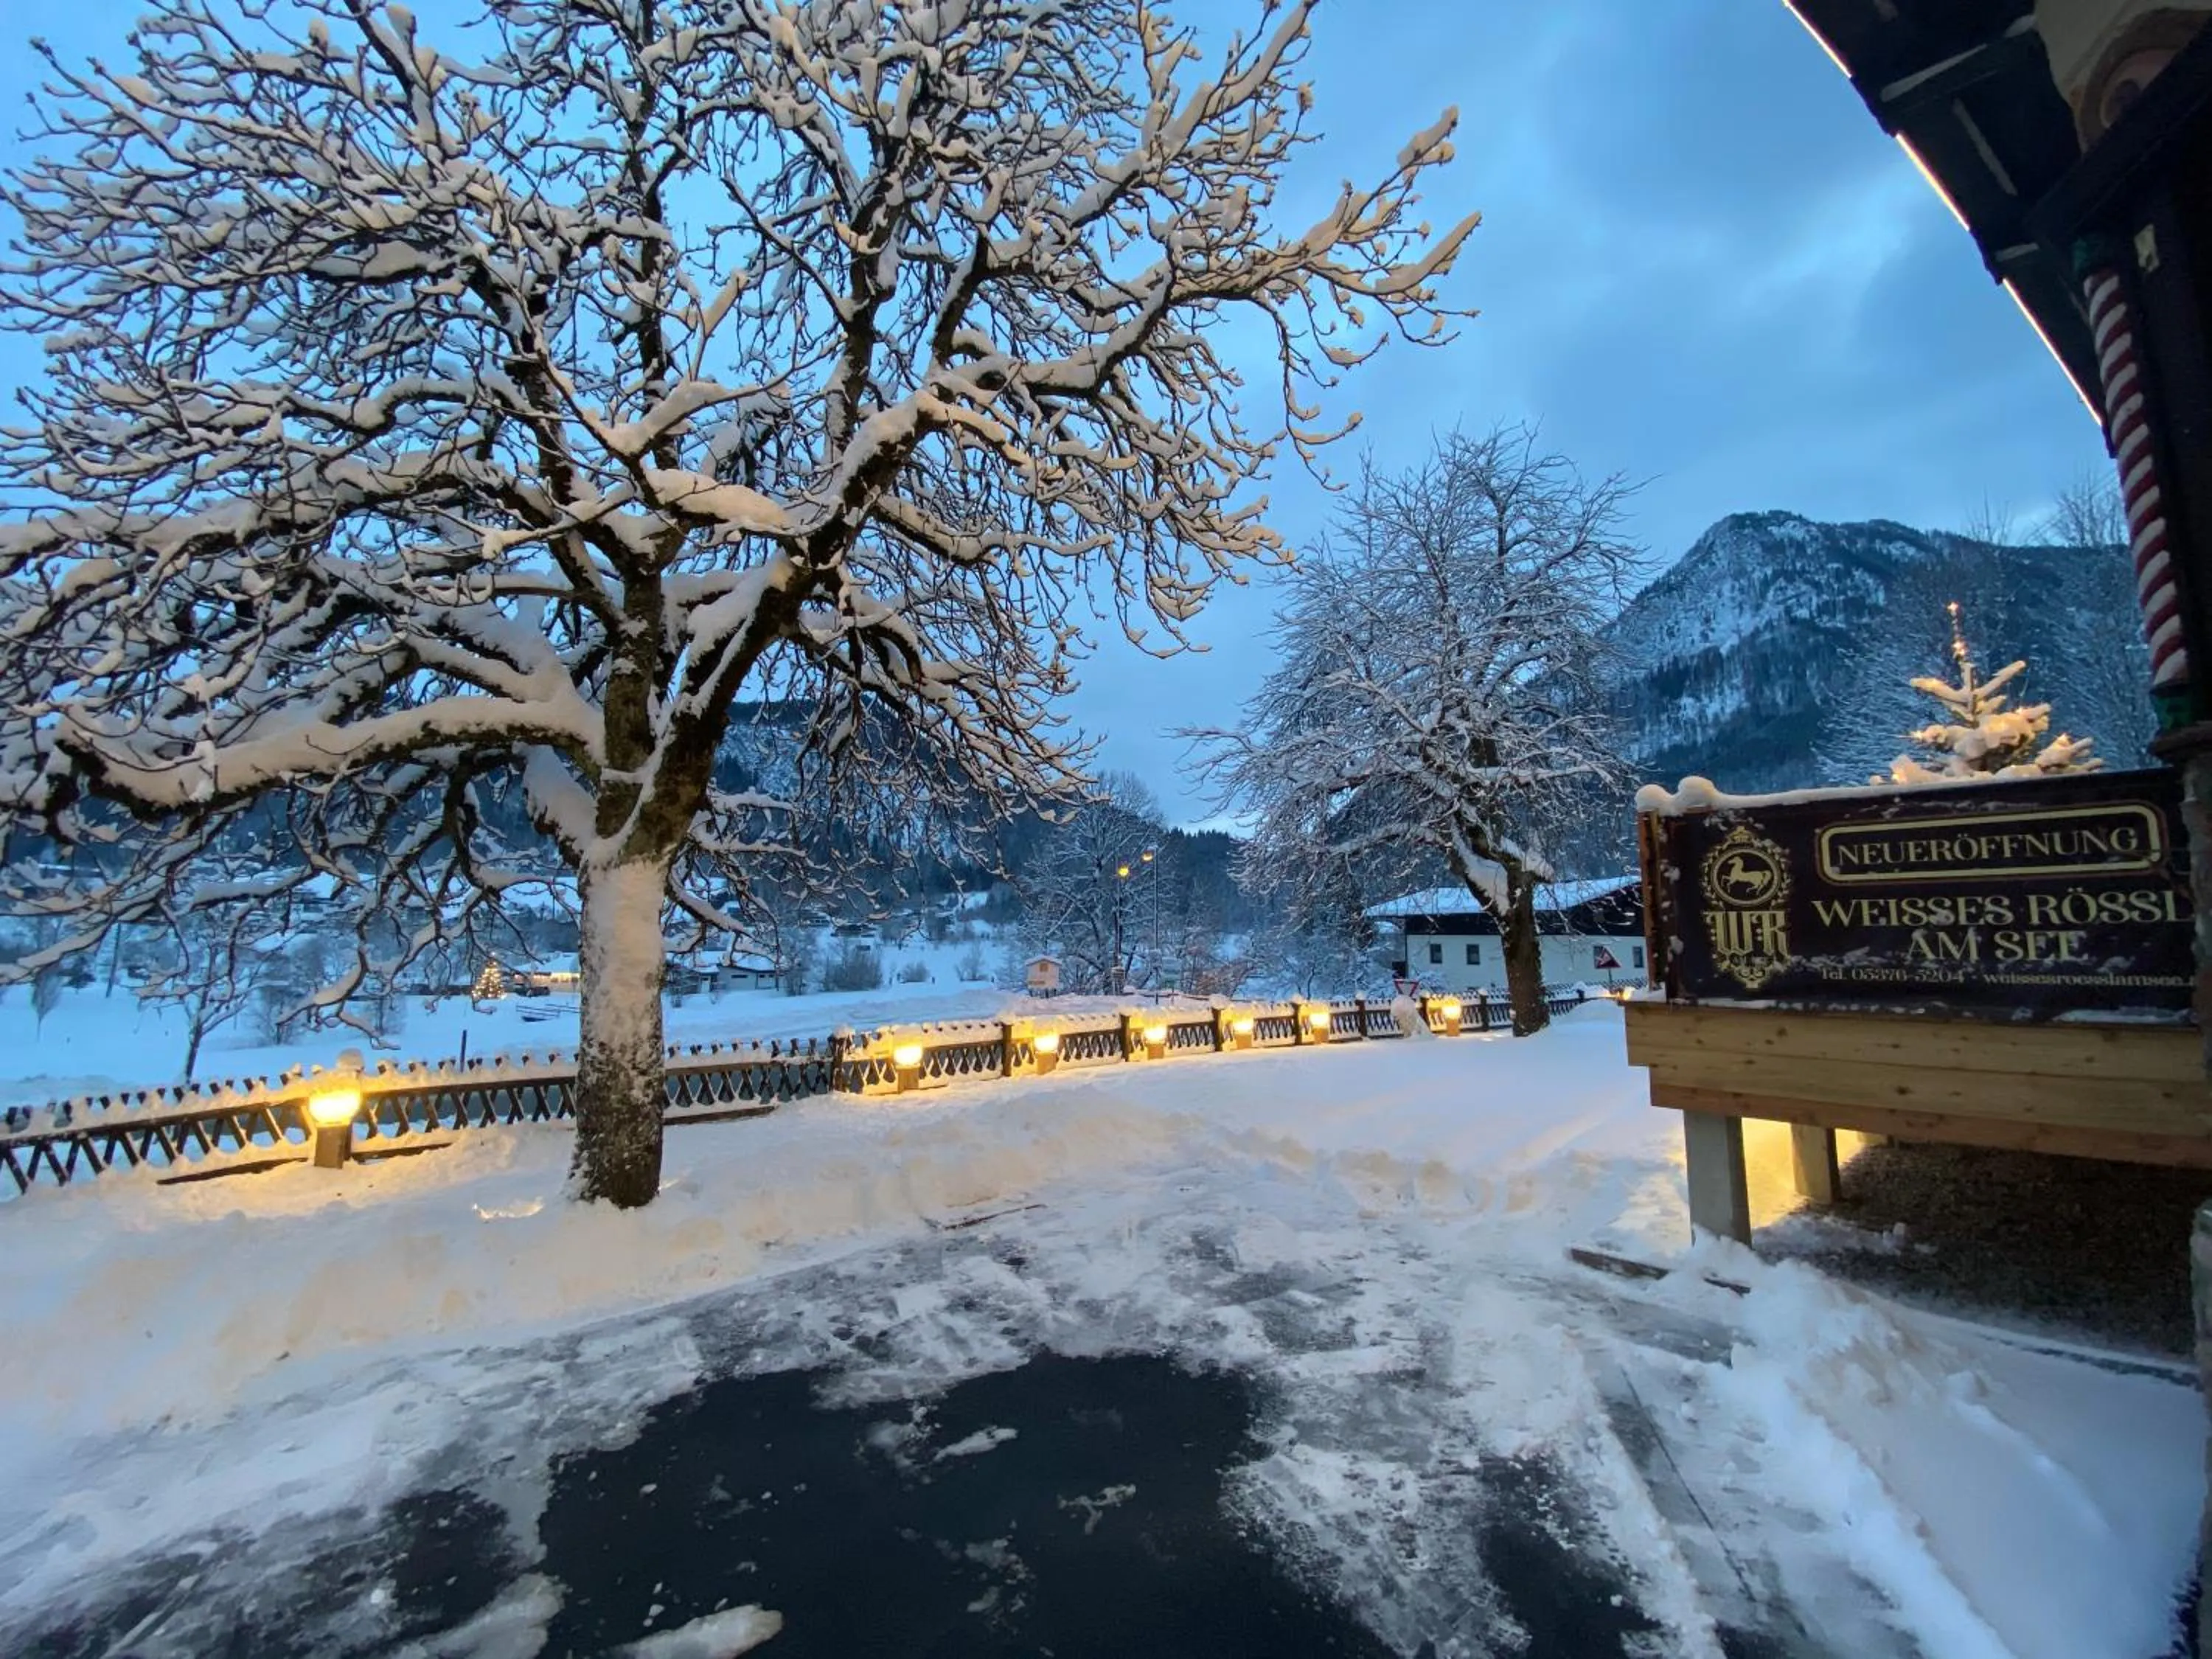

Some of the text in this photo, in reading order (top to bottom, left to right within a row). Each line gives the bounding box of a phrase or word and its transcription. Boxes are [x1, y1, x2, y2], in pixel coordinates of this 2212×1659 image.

[1838, 827, 2138, 865] NEUERÖFFNUNG
[1811, 887, 2194, 927] WEISSES RÖSSL
[1907, 929, 2089, 962] AM SEE
